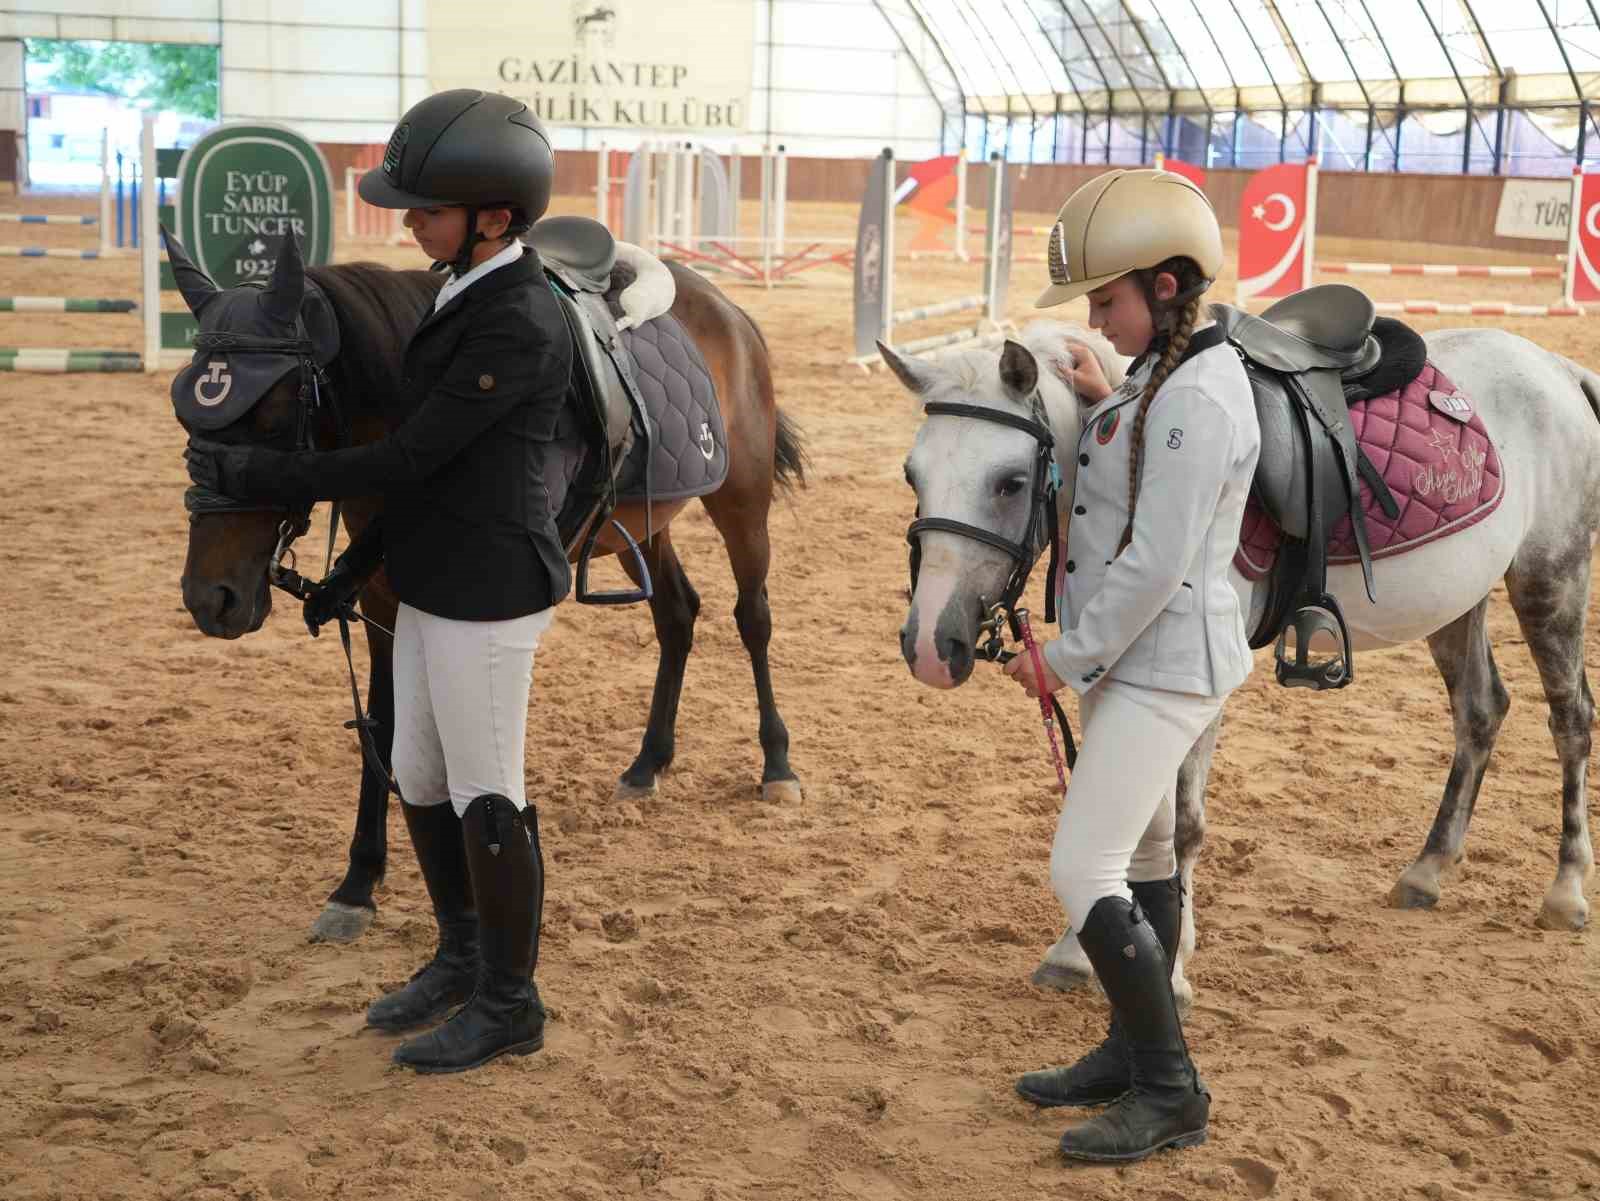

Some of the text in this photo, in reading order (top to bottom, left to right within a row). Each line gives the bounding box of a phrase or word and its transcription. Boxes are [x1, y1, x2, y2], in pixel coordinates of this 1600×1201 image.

[498, 55, 688, 88] GAZİANTEP
[613, 96, 743, 127] KULÜBÜ
[226, 170, 288, 192] EYÜP
[205, 213, 306, 236] TUNCER
